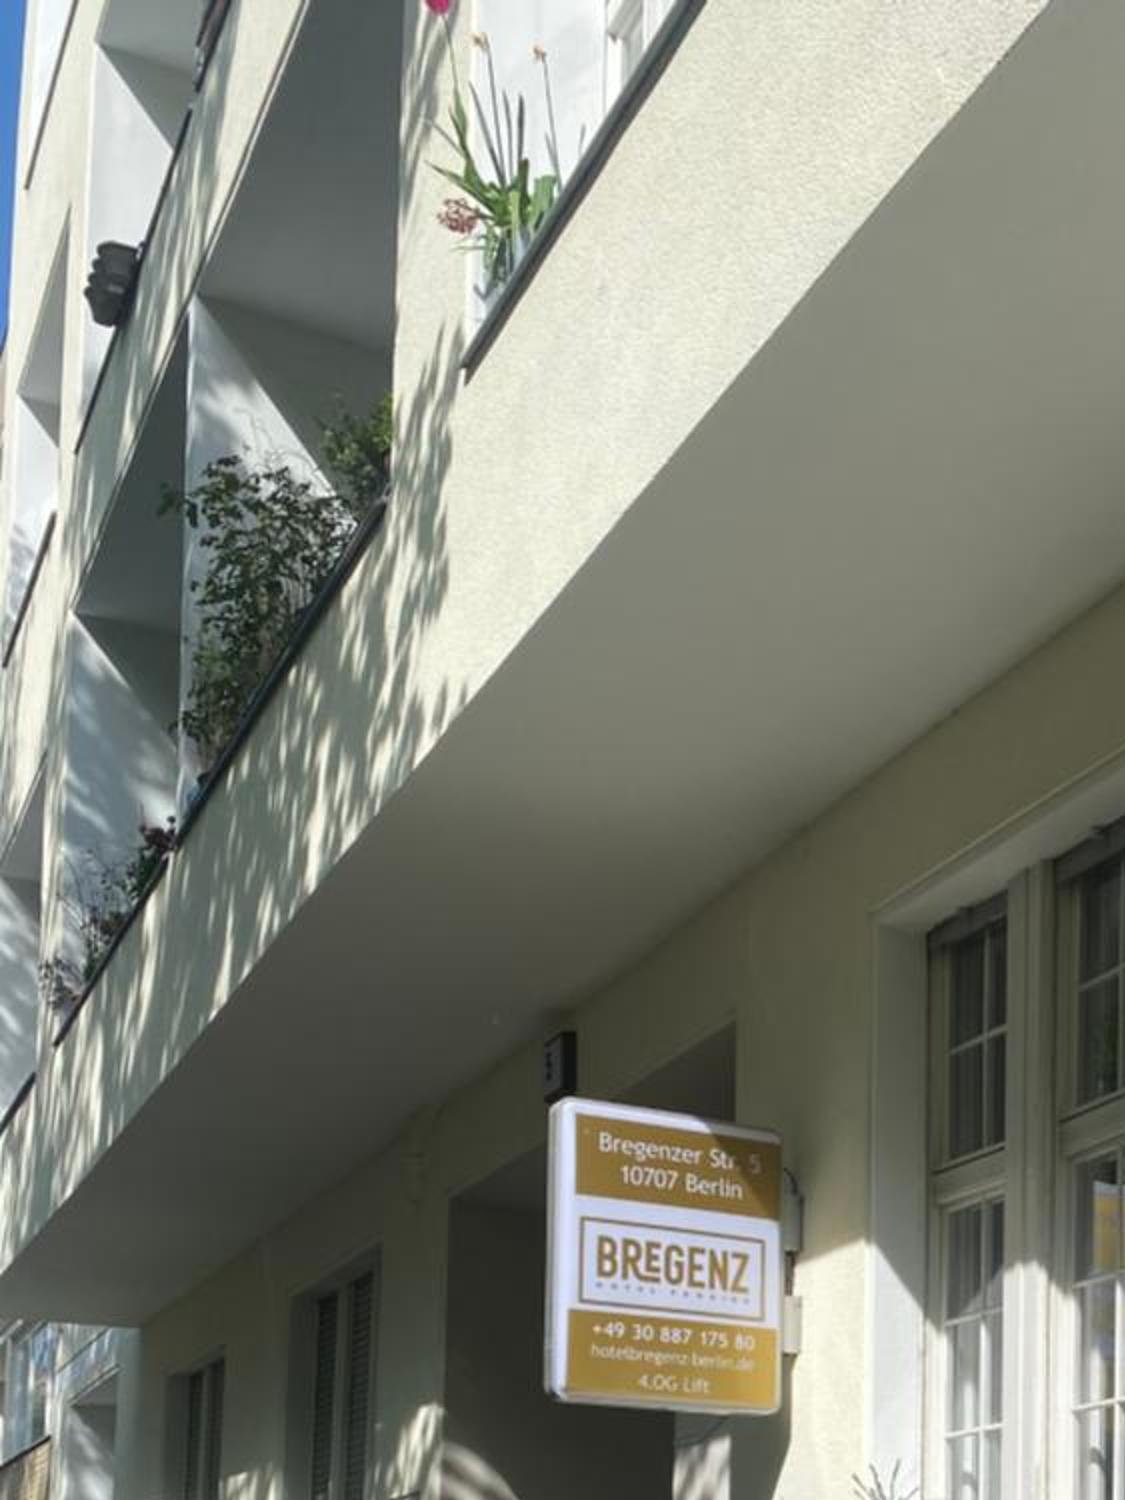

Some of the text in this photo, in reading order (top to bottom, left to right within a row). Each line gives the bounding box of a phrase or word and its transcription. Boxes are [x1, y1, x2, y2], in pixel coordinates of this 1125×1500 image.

[598, 1131, 702, 1162] Bregenzer
[749, 1153, 762, 1174] 5
[620, 1164, 744, 1199] 10707 Berlin
[596, 1234, 750, 1294] BREGENZ
[592, 1320, 625, 1339] +49
[632, 1323, 655, 1341] 30
[659, 1326, 692, 1344] 887
[701, 1330, 729, 1348] 175
